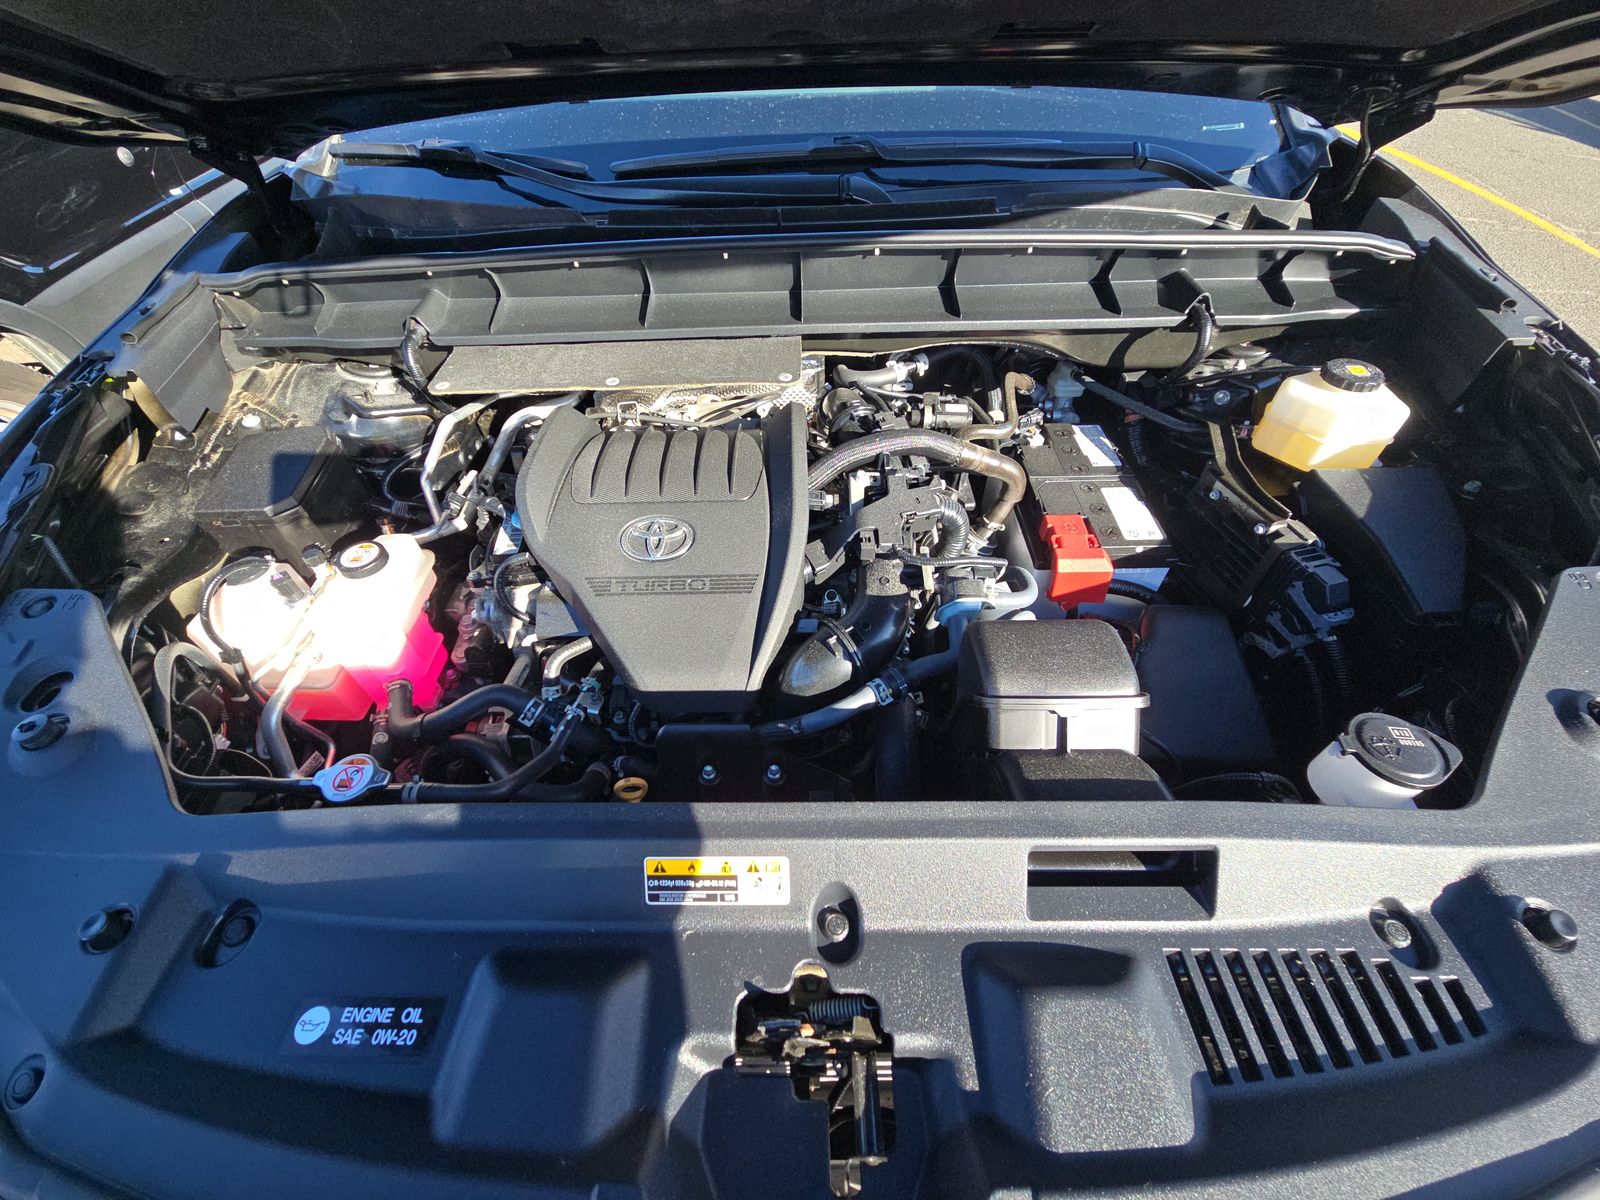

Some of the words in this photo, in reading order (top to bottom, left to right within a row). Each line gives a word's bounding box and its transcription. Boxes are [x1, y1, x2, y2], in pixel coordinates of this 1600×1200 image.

[615, 578, 707, 592] TURBO
[340, 1007, 395, 1023] ENGINE
[401, 1007, 424, 1024] OIL
[331, 1028, 365, 1045] SAE
[371, 1029, 418, 1046] 0W-20
